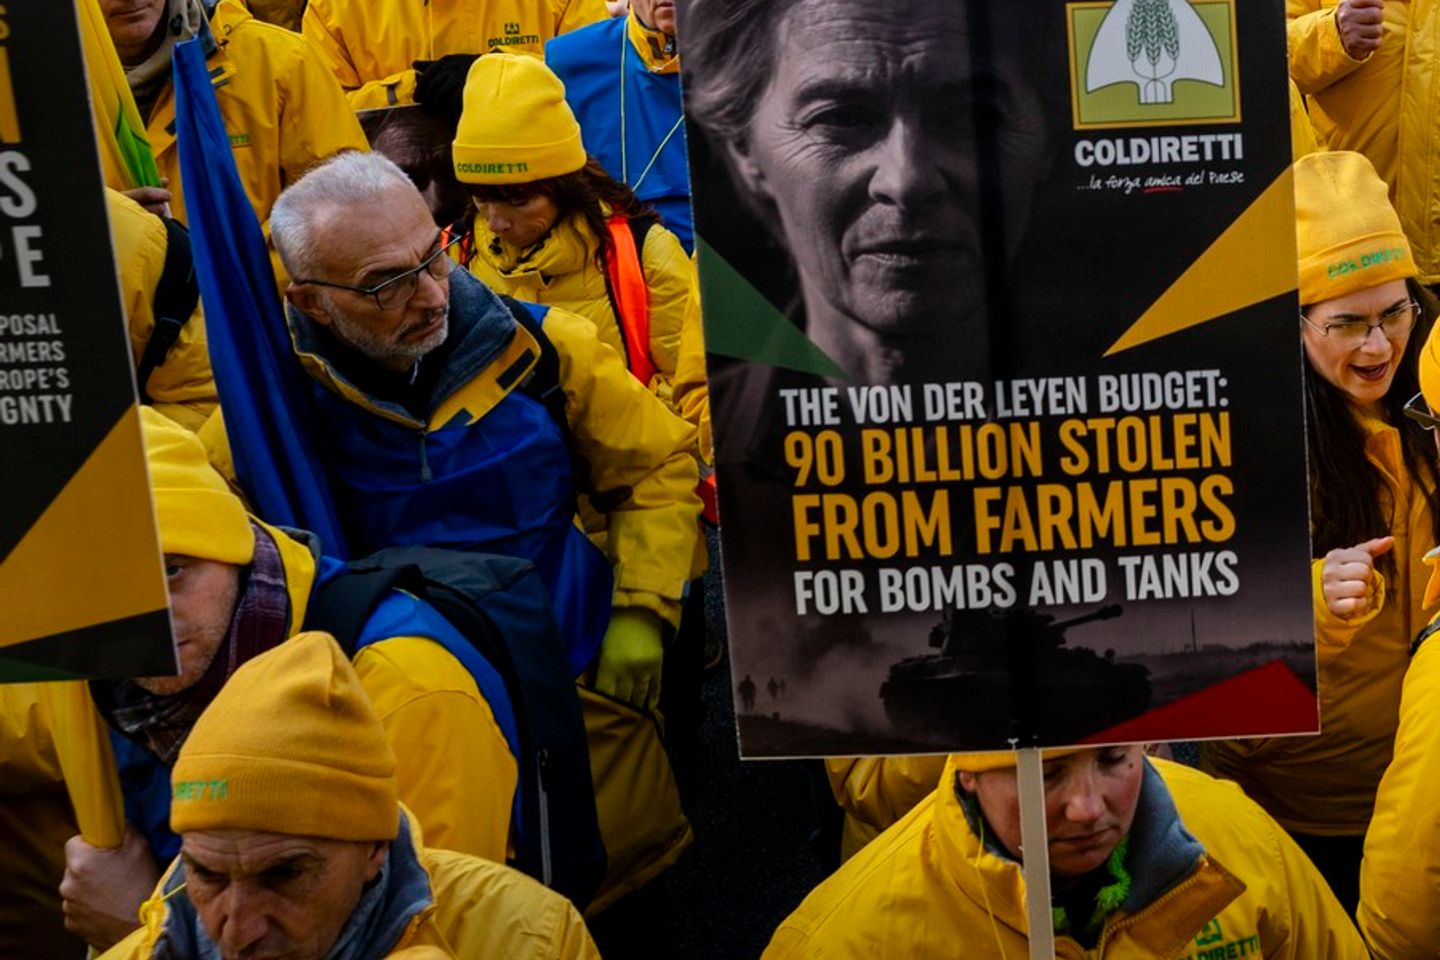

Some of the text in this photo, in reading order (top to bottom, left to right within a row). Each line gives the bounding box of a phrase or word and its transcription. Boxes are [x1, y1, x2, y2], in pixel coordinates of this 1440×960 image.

[488, 35, 539, 48] COLDIRETTI
[1074, 133, 1243, 167] COLDIRETTI
[1105, 175, 1141, 194] forza
[1144, 174, 1182, 187] amica
[1185, 169, 1205, 186] del
[1208, 171, 1246, 185] Paese
[779, 369, 1229, 427] THE VON DER LEYEN BUDGET:
[784, 411, 1233, 488] 90 BILLION STOLEN
[791, 474, 1237, 561] FROM FARMERS
[793, 550, 1240, 615] FOR BOMBS AND TANKS
